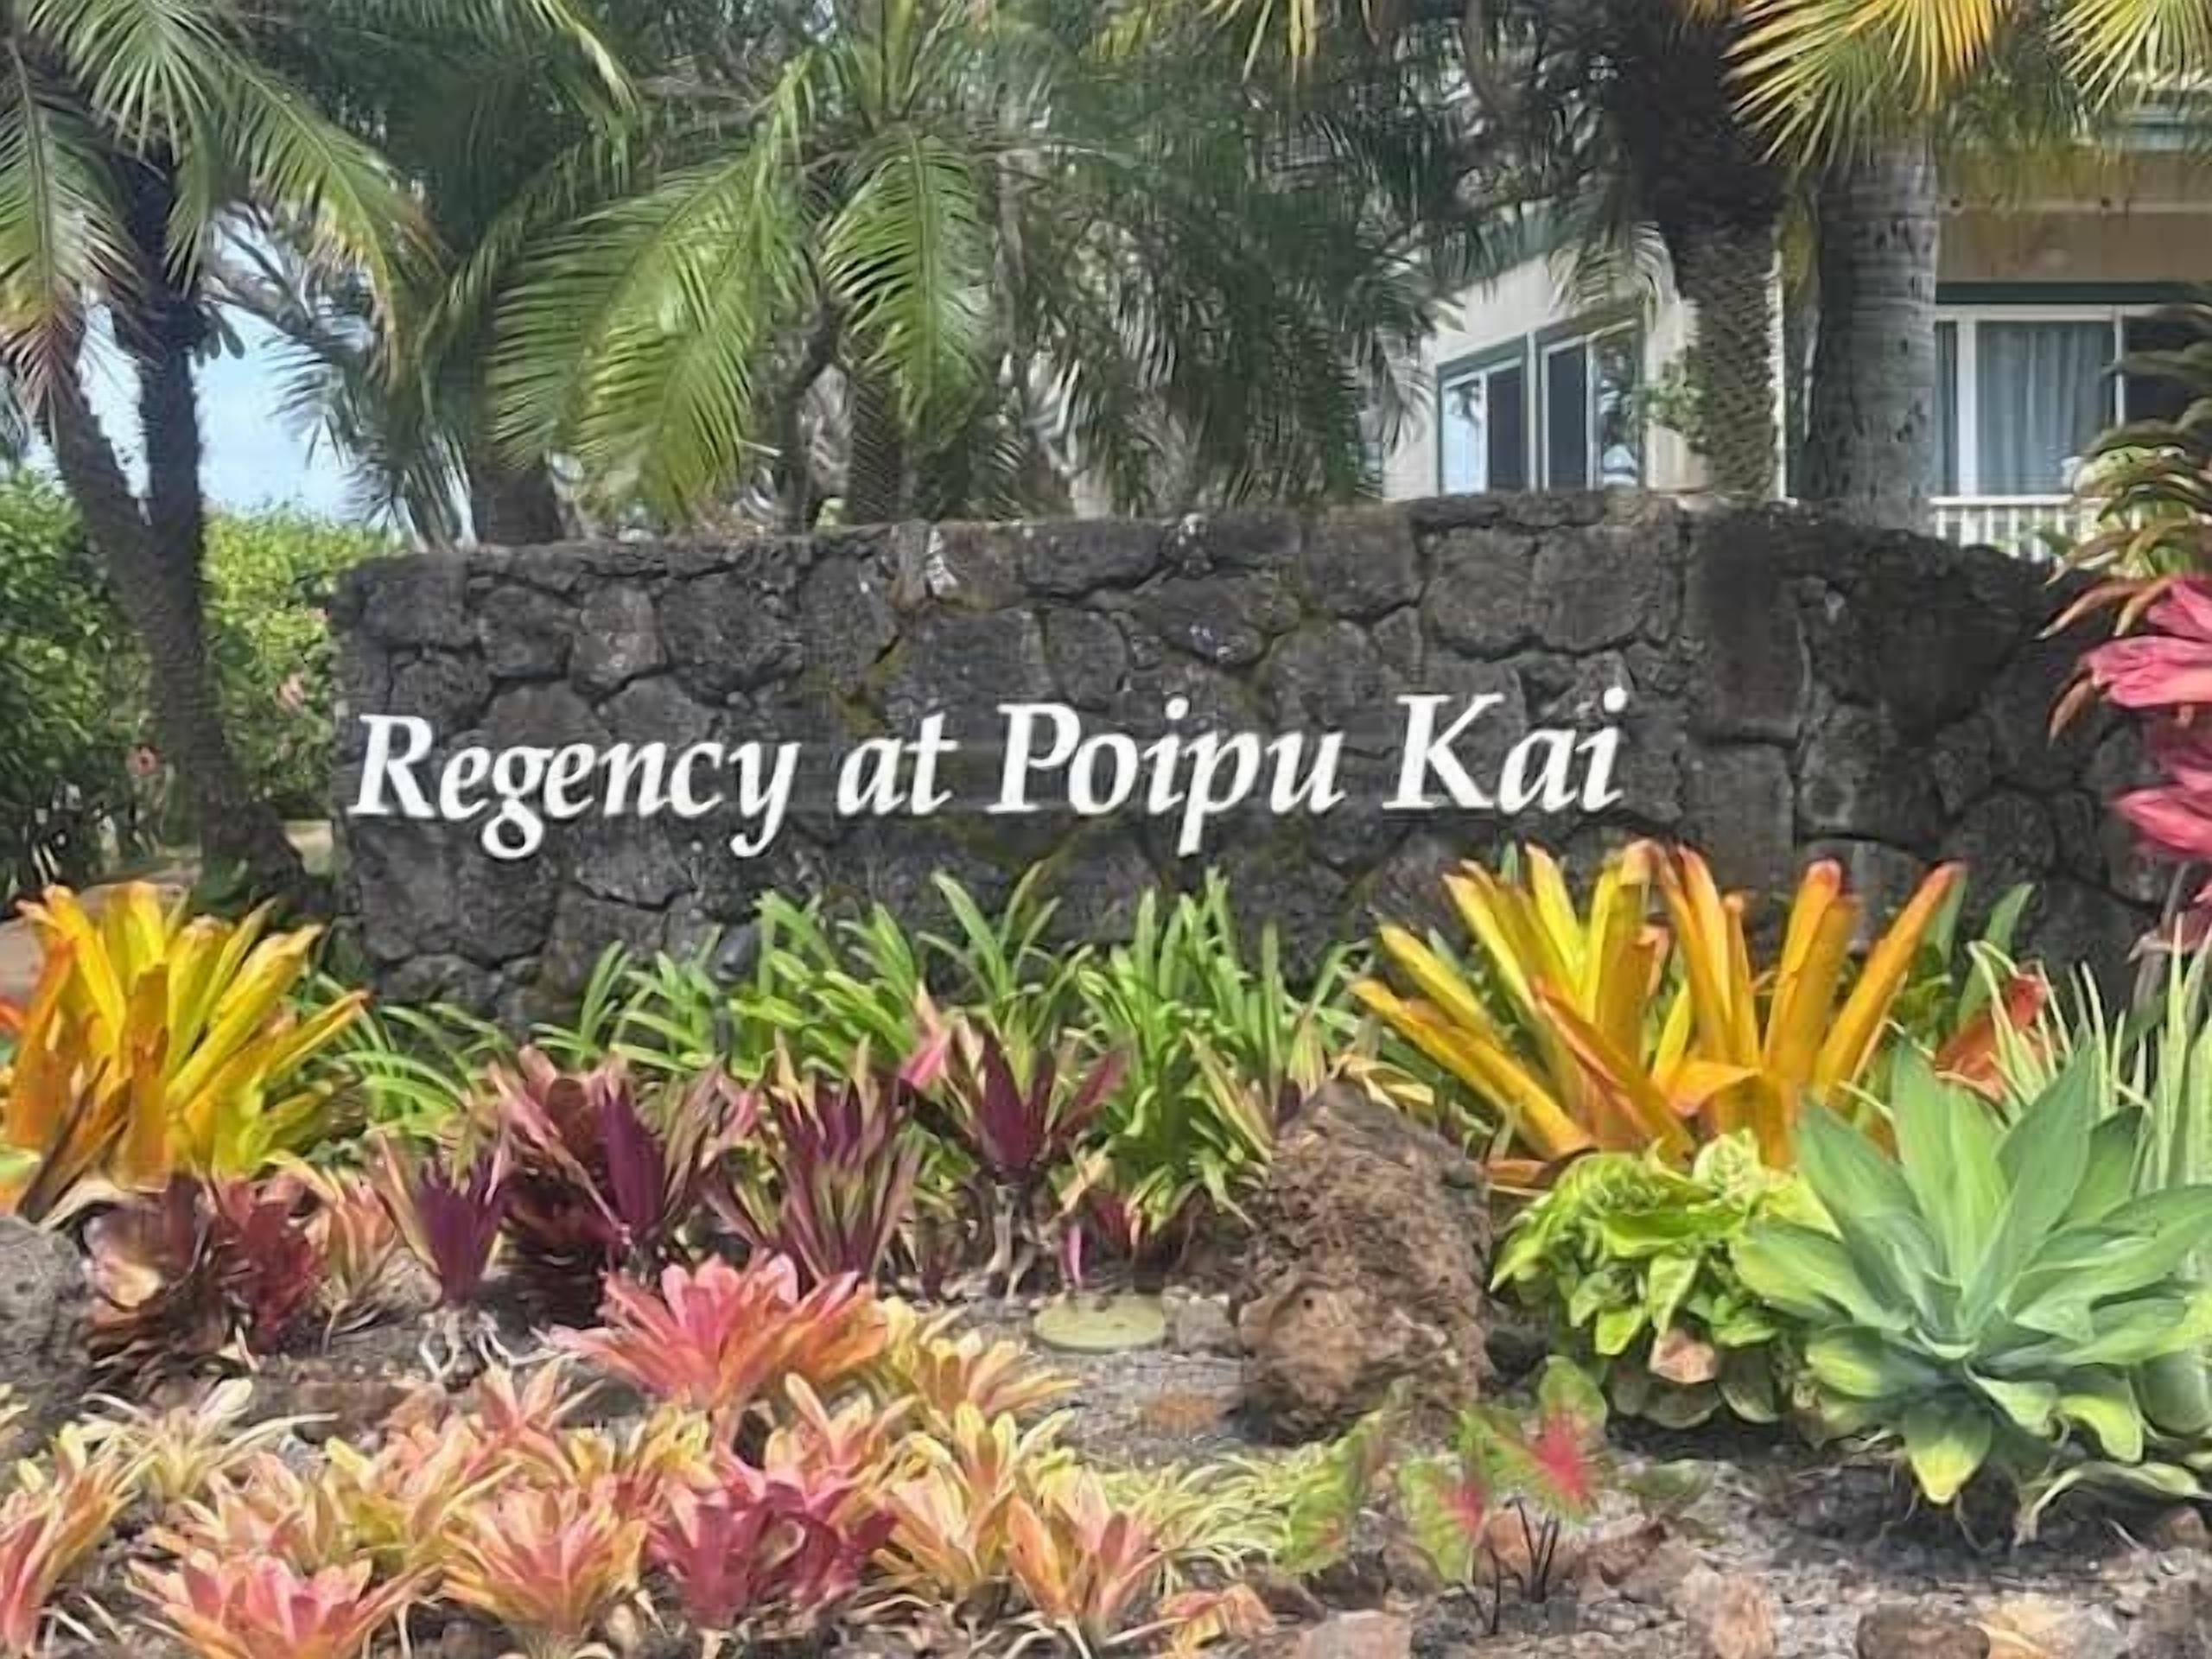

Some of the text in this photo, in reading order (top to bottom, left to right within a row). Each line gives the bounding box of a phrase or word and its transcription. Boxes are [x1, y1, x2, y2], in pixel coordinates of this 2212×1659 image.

[346, 683, 1630, 859] Regency at Poipu Kai
